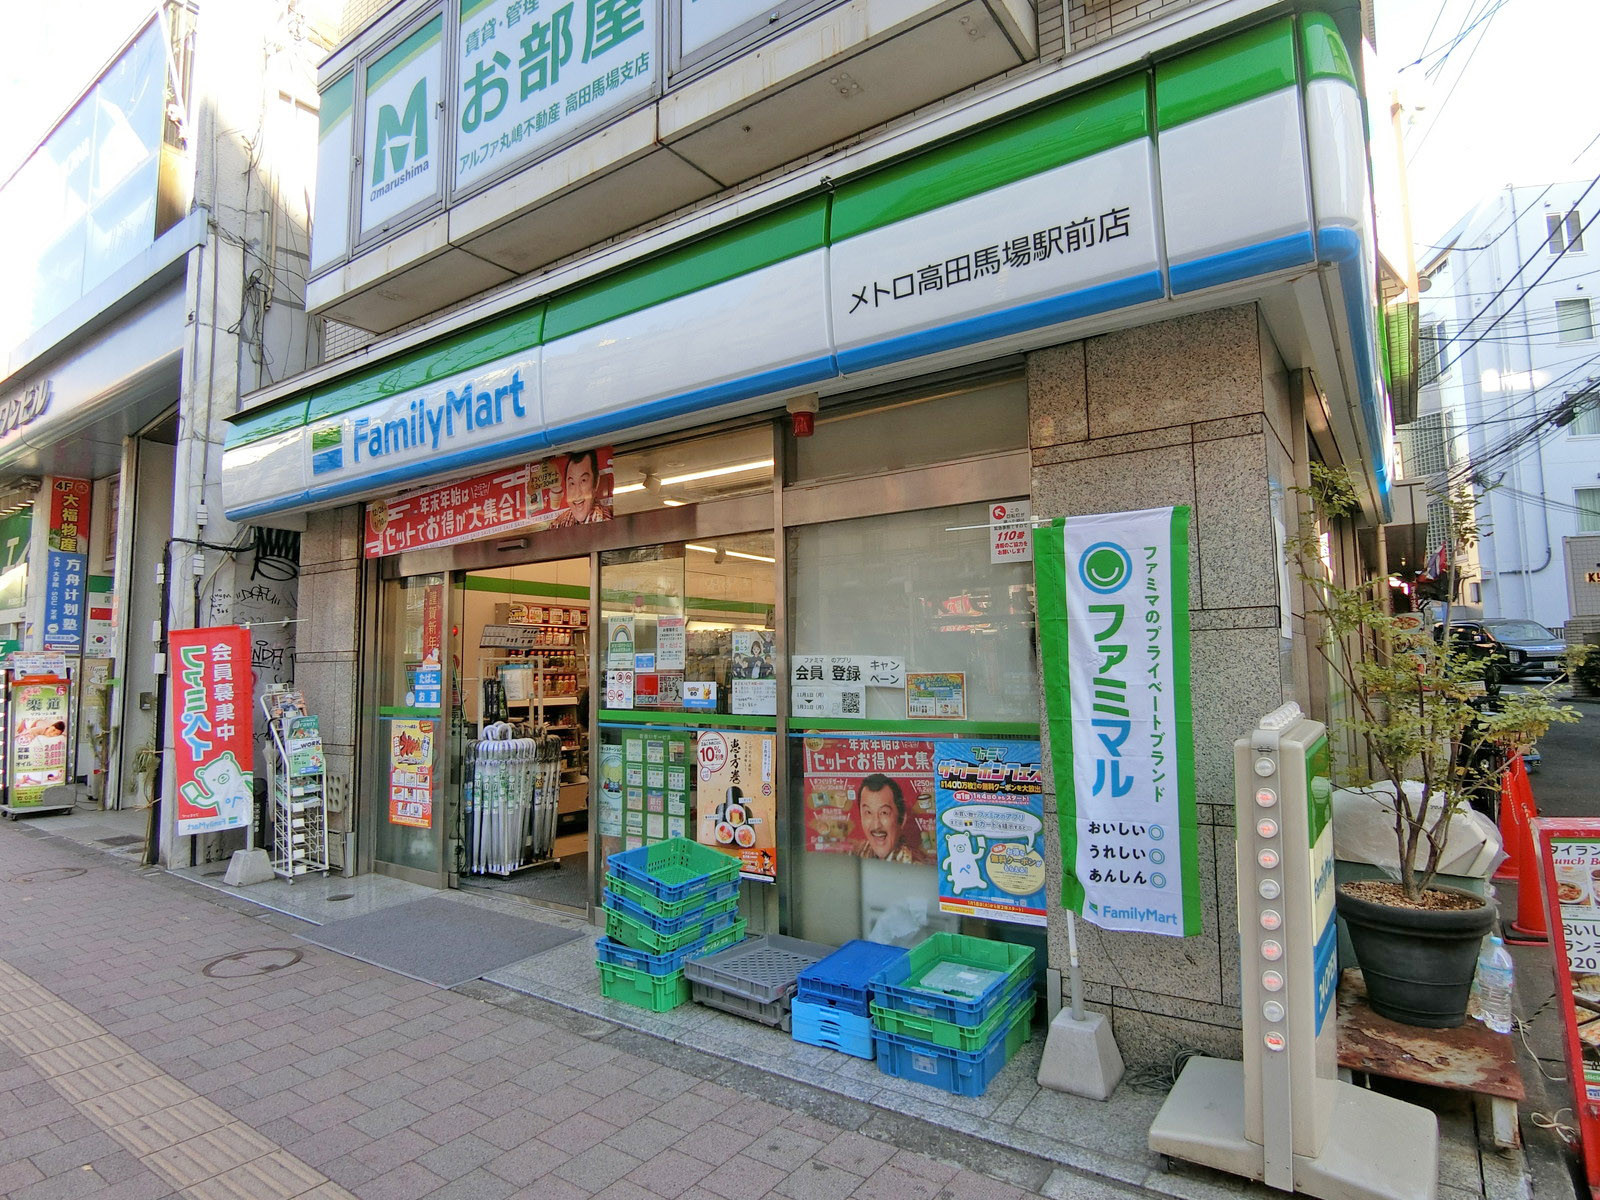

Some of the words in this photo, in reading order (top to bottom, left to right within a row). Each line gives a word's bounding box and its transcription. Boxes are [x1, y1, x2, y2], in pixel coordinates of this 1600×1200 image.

[465, 0, 540, 57] 賃貸・管理
[462, 0, 644, 134] お部屋
[460, 103, 561, 175] アルファ丸嶋不動産
[565, 52, 650, 114] 高田馬場支店
[849, 207, 1131, 314] メトロ高田馬場駅前店
[354, 369, 526, 463] FamilyMart
[55, 481, 73, 491] 4F
[420, 486, 470, 514] 年末年始は
[60, 494, 79, 552] 大福物産
[384, 490, 521, 550] セットでお得が大集合!
[997, 530, 1025, 541] 110番
[62, 559, 82, 631] 方舟计划塾
[427, 590, 437, 649] 謹賀新年
[795, 665, 824, 681] 会員
[832, 665, 861, 682] 登録
[870, 660, 900, 671] キャン
[1143, 546, 1166, 803] ファミマのプライベートブランド
[418, 673, 437, 684] たばこ
[870, 675, 900, 684] ペーン
[637, 695, 658, 703] SECOM
[1088, 603, 1134, 799] ファミマル
[849, 739, 900, 751] 年末年始は
[971, 747, 1008, 760] ファミマ
[729, 738, 741, 785] 恵方巻
[1088, 820, 1146, 837] おいしい
[1088, 845, 1147, 860] うれしい
[1554, 857, 1585, 865] unch
[960, 864, 971, 874] ペ
[1088, 868, 1148, 885] あんしん
[1103, 905, 1178, 926] FamilyMart
